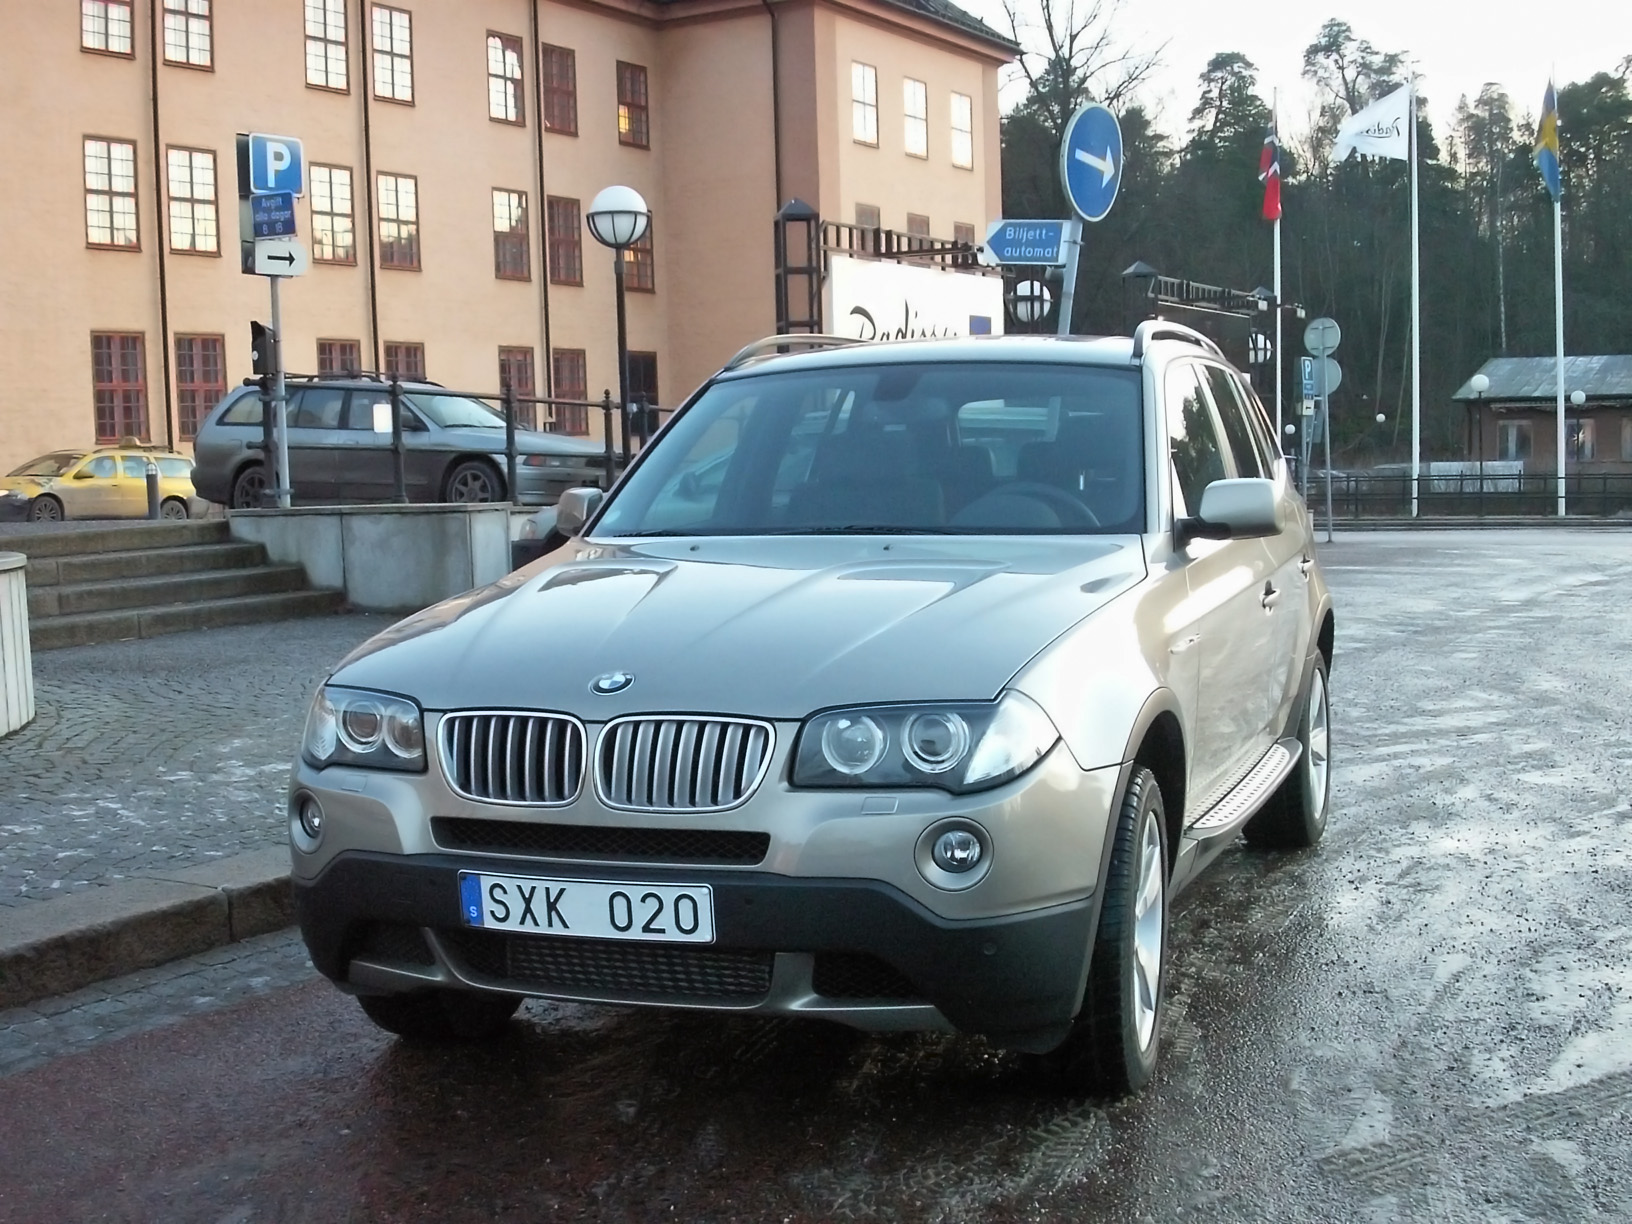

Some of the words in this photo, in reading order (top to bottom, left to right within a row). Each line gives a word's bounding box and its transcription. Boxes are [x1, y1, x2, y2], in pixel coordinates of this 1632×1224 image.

[266, 141, 291, 188] P
[271, 210, 291, 221] dagar
[1005, 226, 1054, 243] Biljett-
[1004, 245, 1058, 257] automat
[1304, 360, 1312, 380] P
[469, 906, 478, 917] S
[488, 882, 570, 929] SXK
[608, 890, 700, 935] 020
